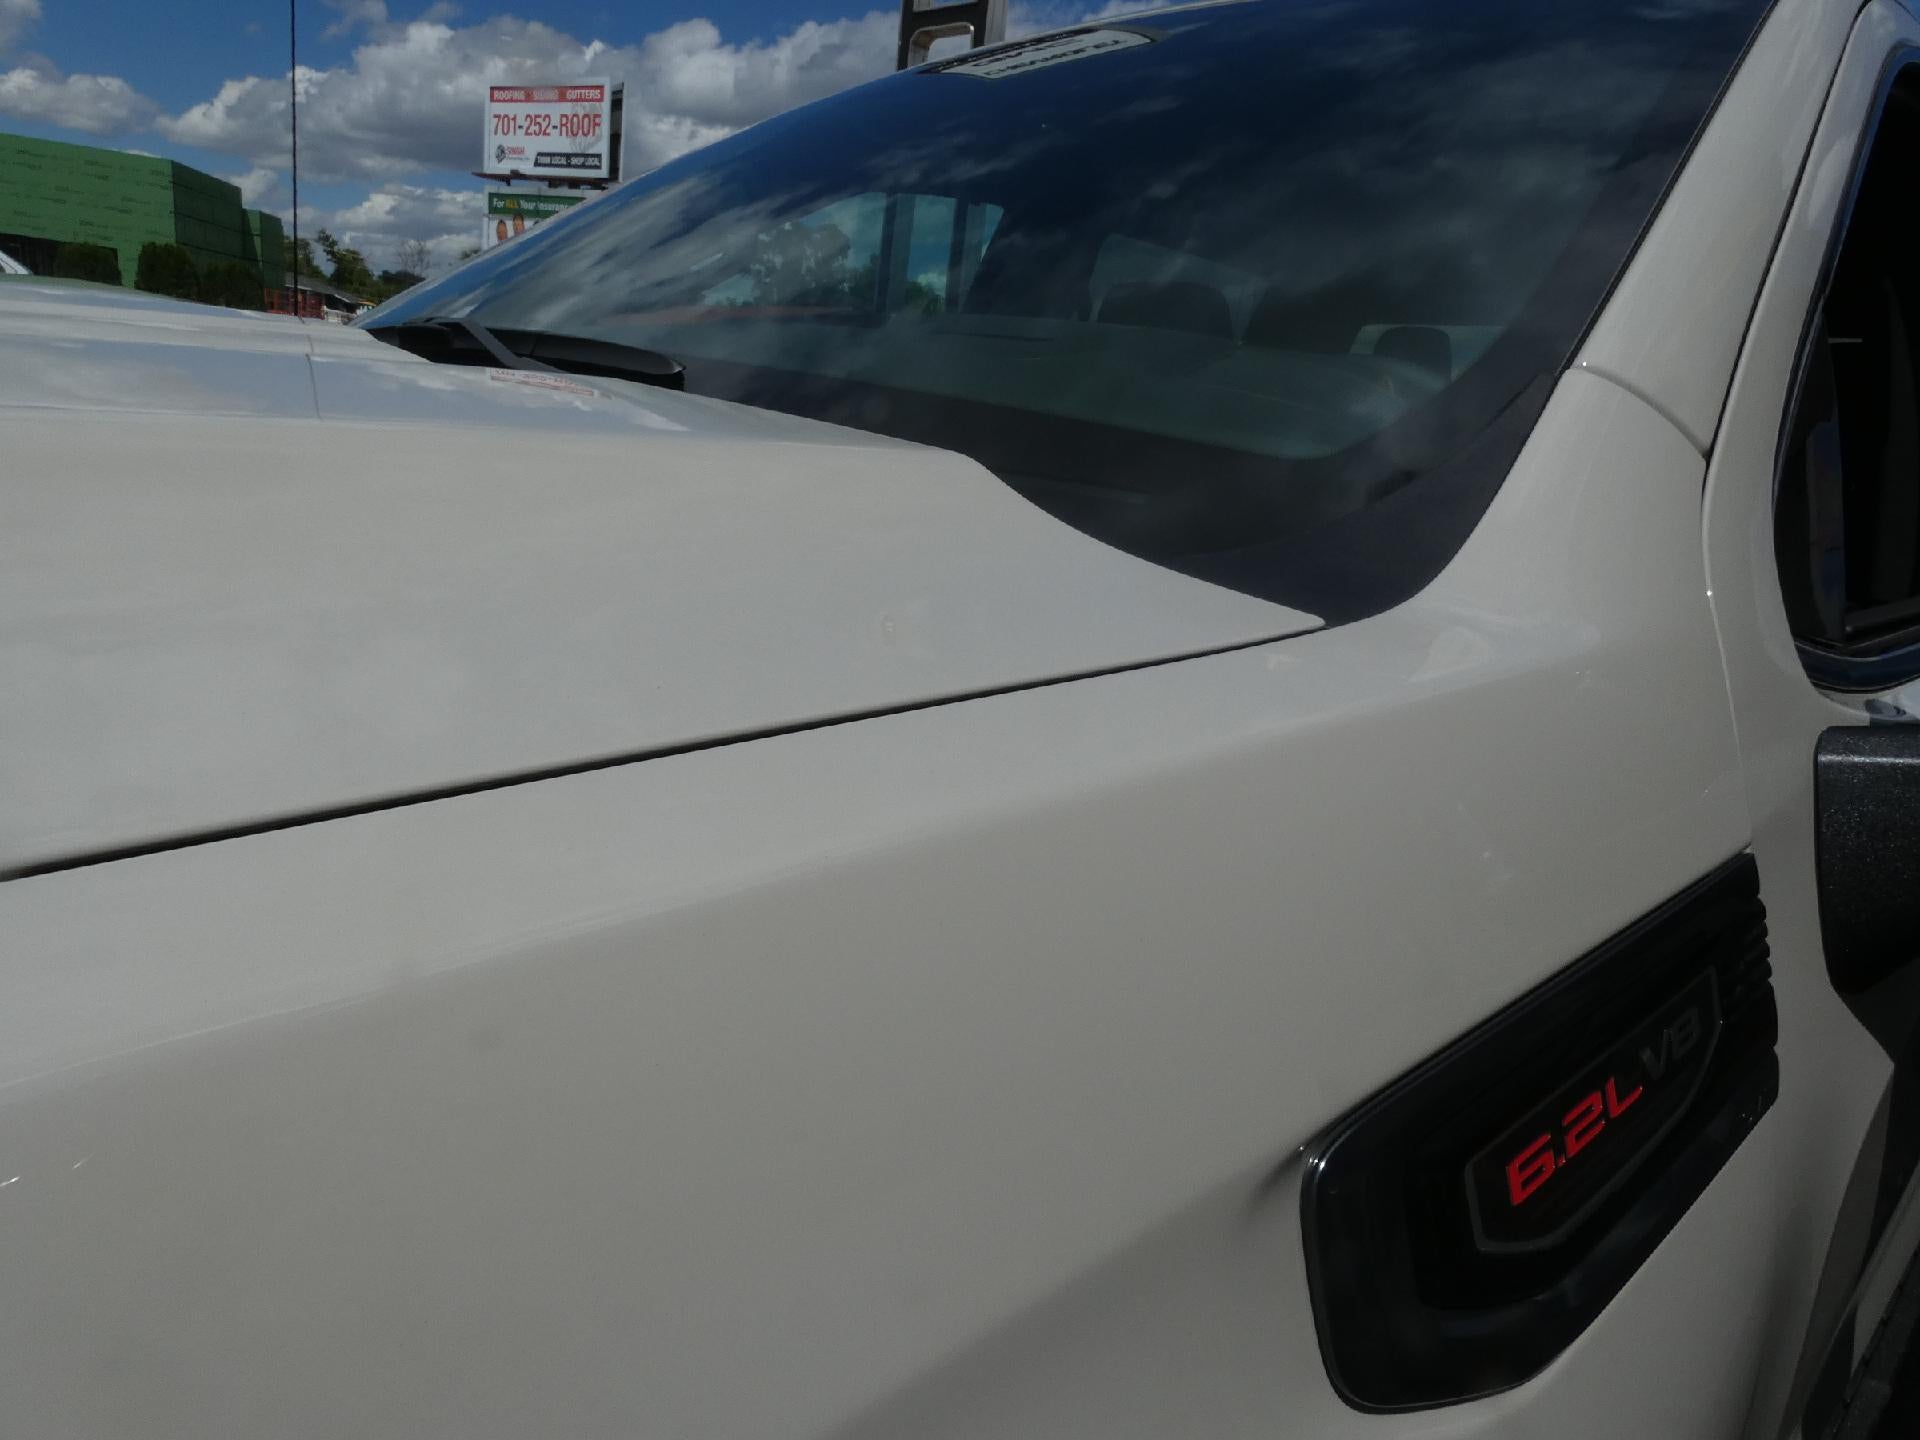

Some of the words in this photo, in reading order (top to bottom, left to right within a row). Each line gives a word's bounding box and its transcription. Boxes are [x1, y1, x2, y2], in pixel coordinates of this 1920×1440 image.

[494, 89, 526, 101] ROOFING
[566, 89, 601, 100] GUTTERS
[493, 113, 602, 137] 701-252-ROOF
[493, 198, 505, 208] For
[520, 200, 536, 210] Your
[1507, 1076, 1642, 1206] 6.2L
